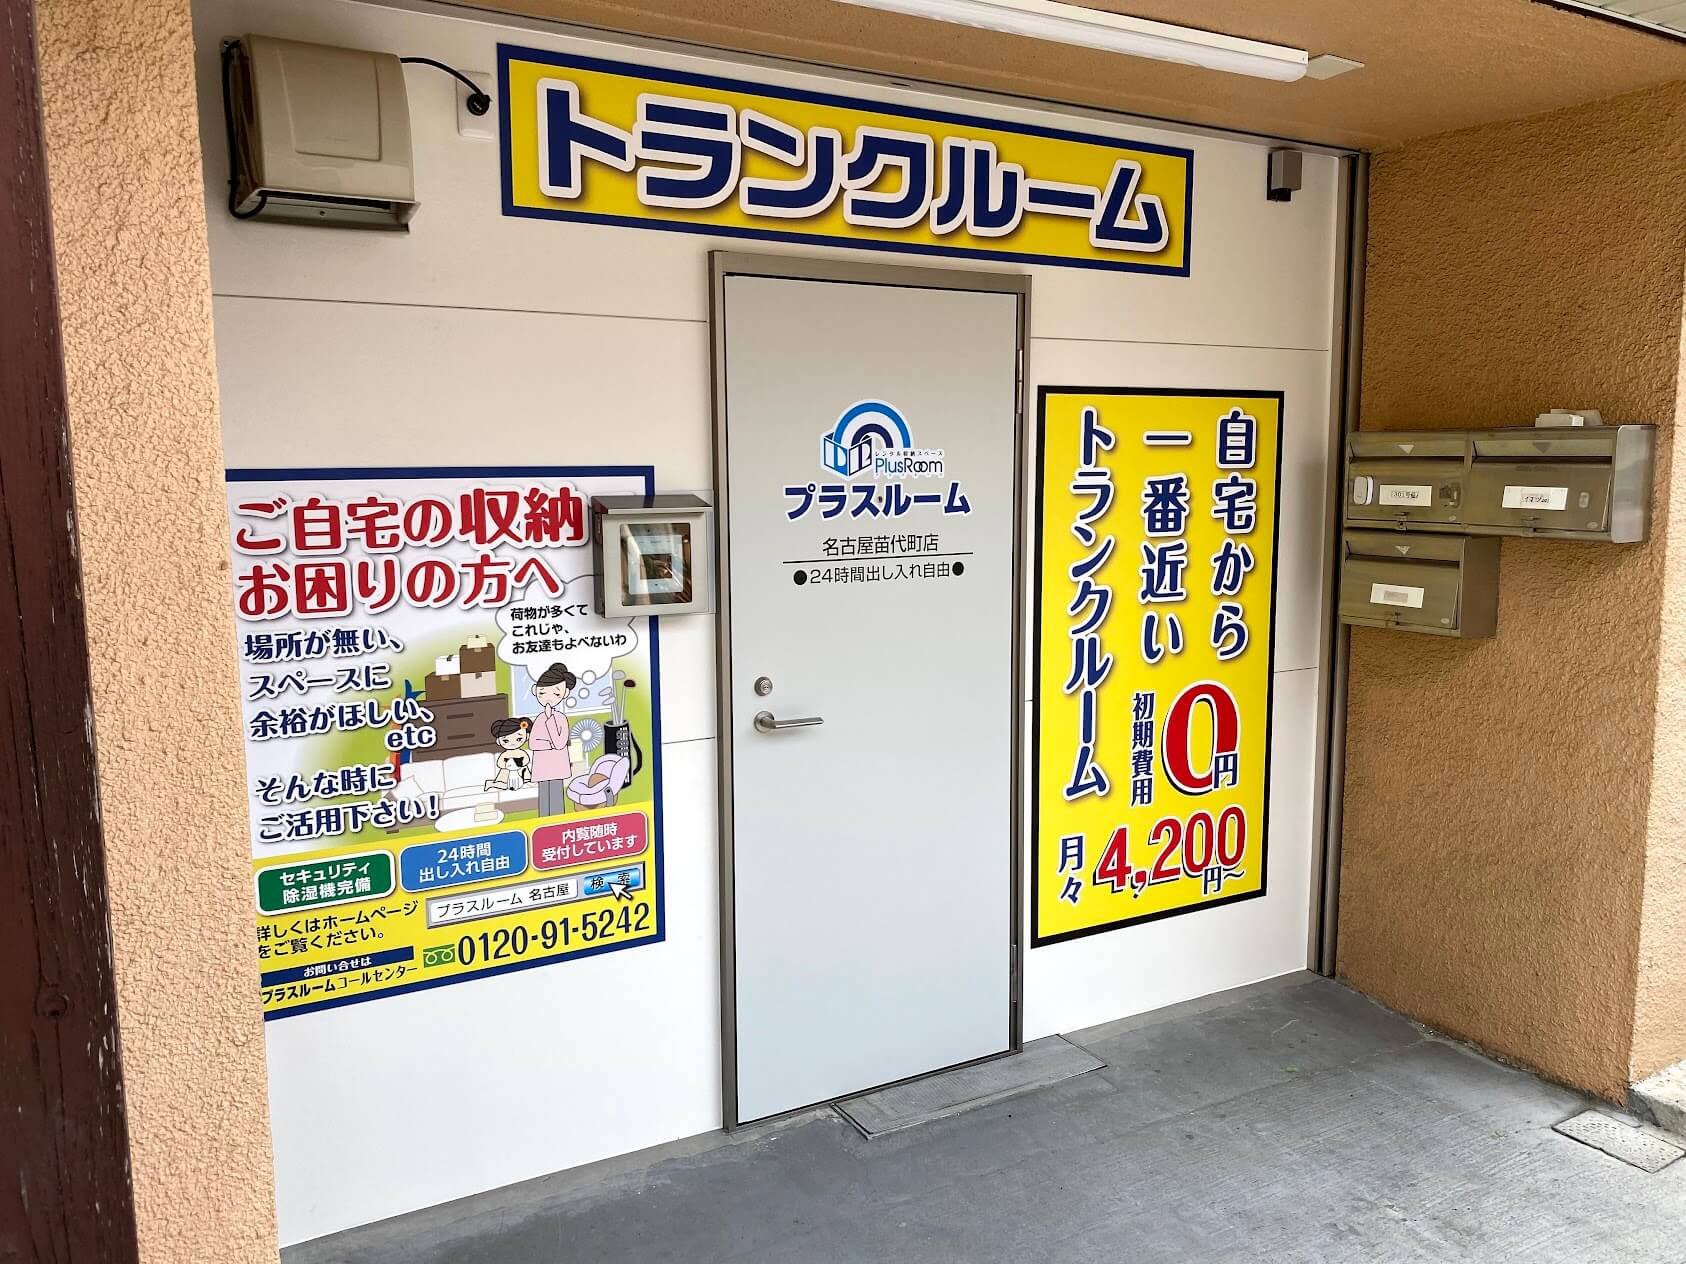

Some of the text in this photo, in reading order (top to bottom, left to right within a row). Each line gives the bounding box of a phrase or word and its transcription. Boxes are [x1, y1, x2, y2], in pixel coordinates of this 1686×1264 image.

[544, 86, 1166, 250] トランクルーム
[875, 457, 943, 473] PlusRoom
[785, 482, 971, 520] プラスルーム
[235, 486, 586, 553] ご自宅の収納
[1210, 410, 1256, 659] 自宅から
[822, 534, 939, 557] 名古屋苗代町店
[1140, 430, 1191, 663] 一番近い
[238, 553, 562, 617] お困りの方へ
[510, 604, 588, 621] 荷物が多くて
[1064, 409, 1115, 800] トランクルーム
[244, 629, 403, 661] 場所が無い、
[511, 623, 570, 637] これじゃ、
[512, 634, 627, 654] お友達もよべないわ
[248, 664, 391, 699] スペースに
[249, 700, 436, 740] 余裕がほしい、
[386, 726, 436, 750] etc
[1130, 691, 1156, 807] 初期費用
[256, 763, 396, 802] そんな時に
[258, 795, 440, 841] ご活用下さい！
[562, 822, 618, 844] 内覧随時
[438, 842, 492, 864] 24時間
[541, 834, 638, 863] 受付しています
[280, 859, 371, 886] セキュリティ
[418, 856, 510, 883] 出し入れ自由
[1058, 835, 1085, 905] 月々
[282, 876, 371, 905] 除湿機完備
[436, 882, 570, 918] プラスルーム 名古屋
[256, 900, 419, 942] 詳しくはホームページ
[457, 902, 651, 965] 0120-91-5242
[257, 927, 384, 959] をご覧ください。
[303, 956, 372, 978] お問い合せは
